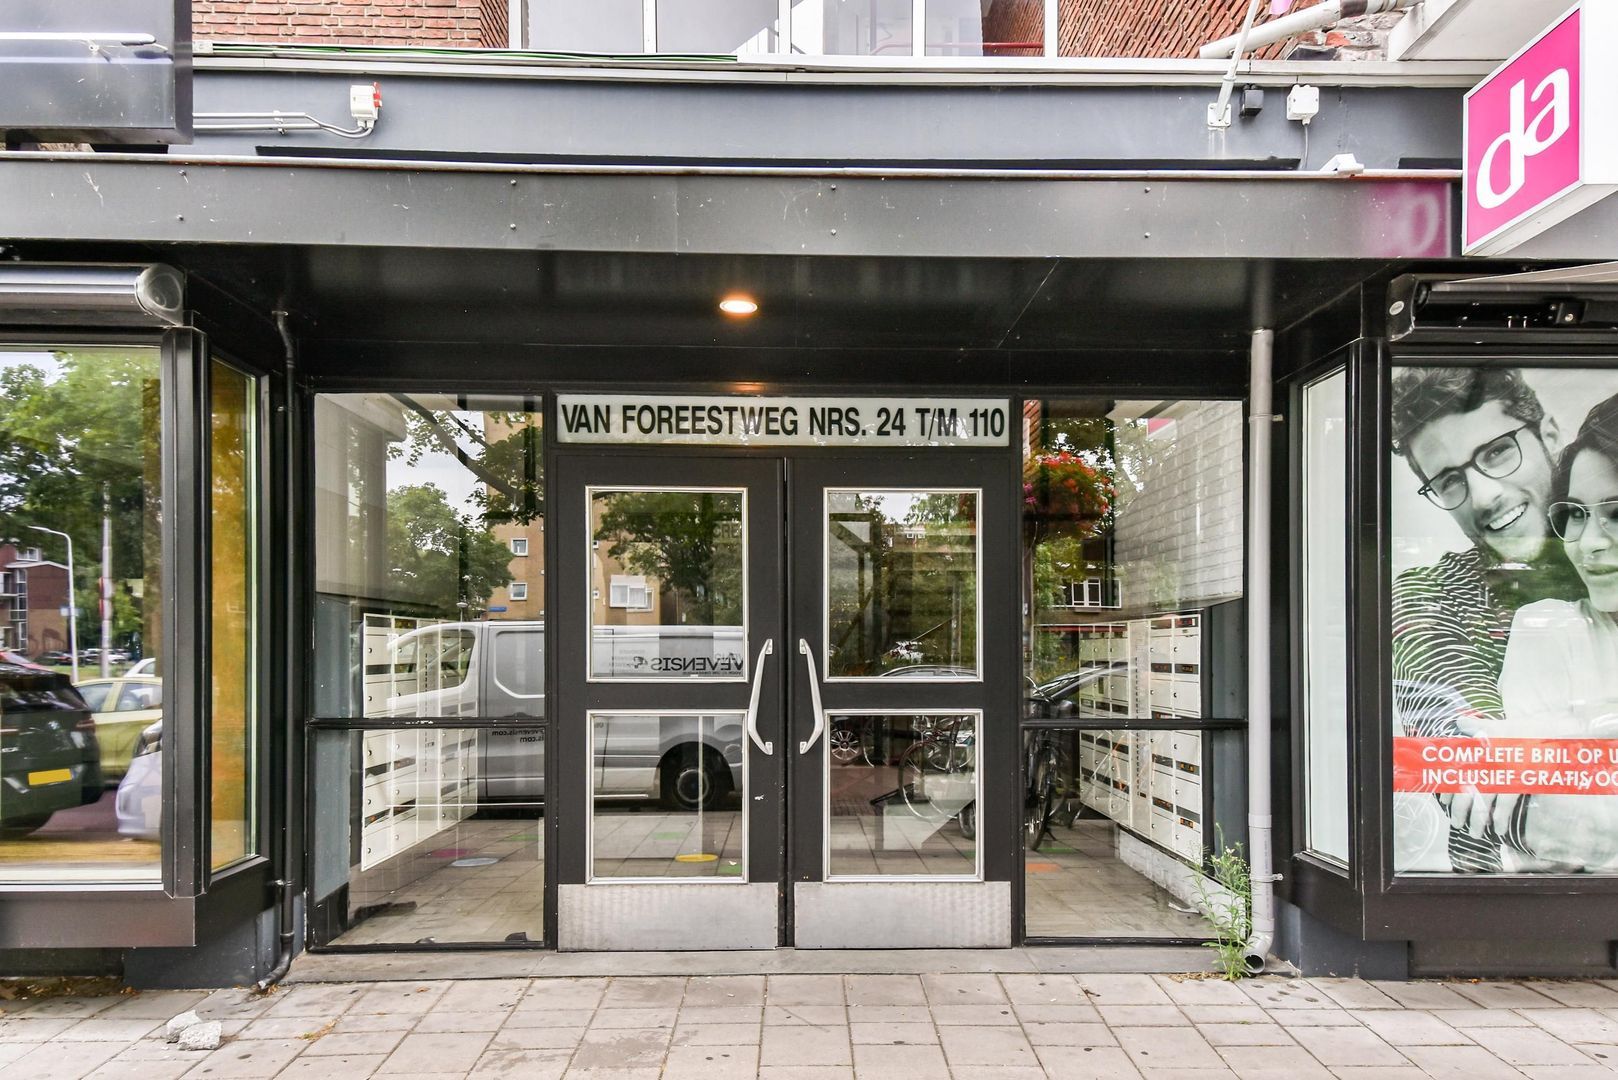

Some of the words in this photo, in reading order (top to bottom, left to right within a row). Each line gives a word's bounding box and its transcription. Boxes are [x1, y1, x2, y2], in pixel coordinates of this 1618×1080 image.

[1475, 67, 1570, 209] da
[560, 404, 611, 434] VAN
[622, 404, 798, 436] FOREESTWEG
[809, 406, 867, 436] NRS.
[876, 407, 906, 436] 24
[915, 407, 958, 440] T/M
[968, 408, 1005, 437] 110
[1421, 746, 1524, 763] COMPLETE
[1531, 747, 1571, 764] BRIL
[1577, 748, 1603, 765] OP
[1421, 768, 1515, 786] INCLUSIEF
[1520, 769, 1590, 787] GRATIS
